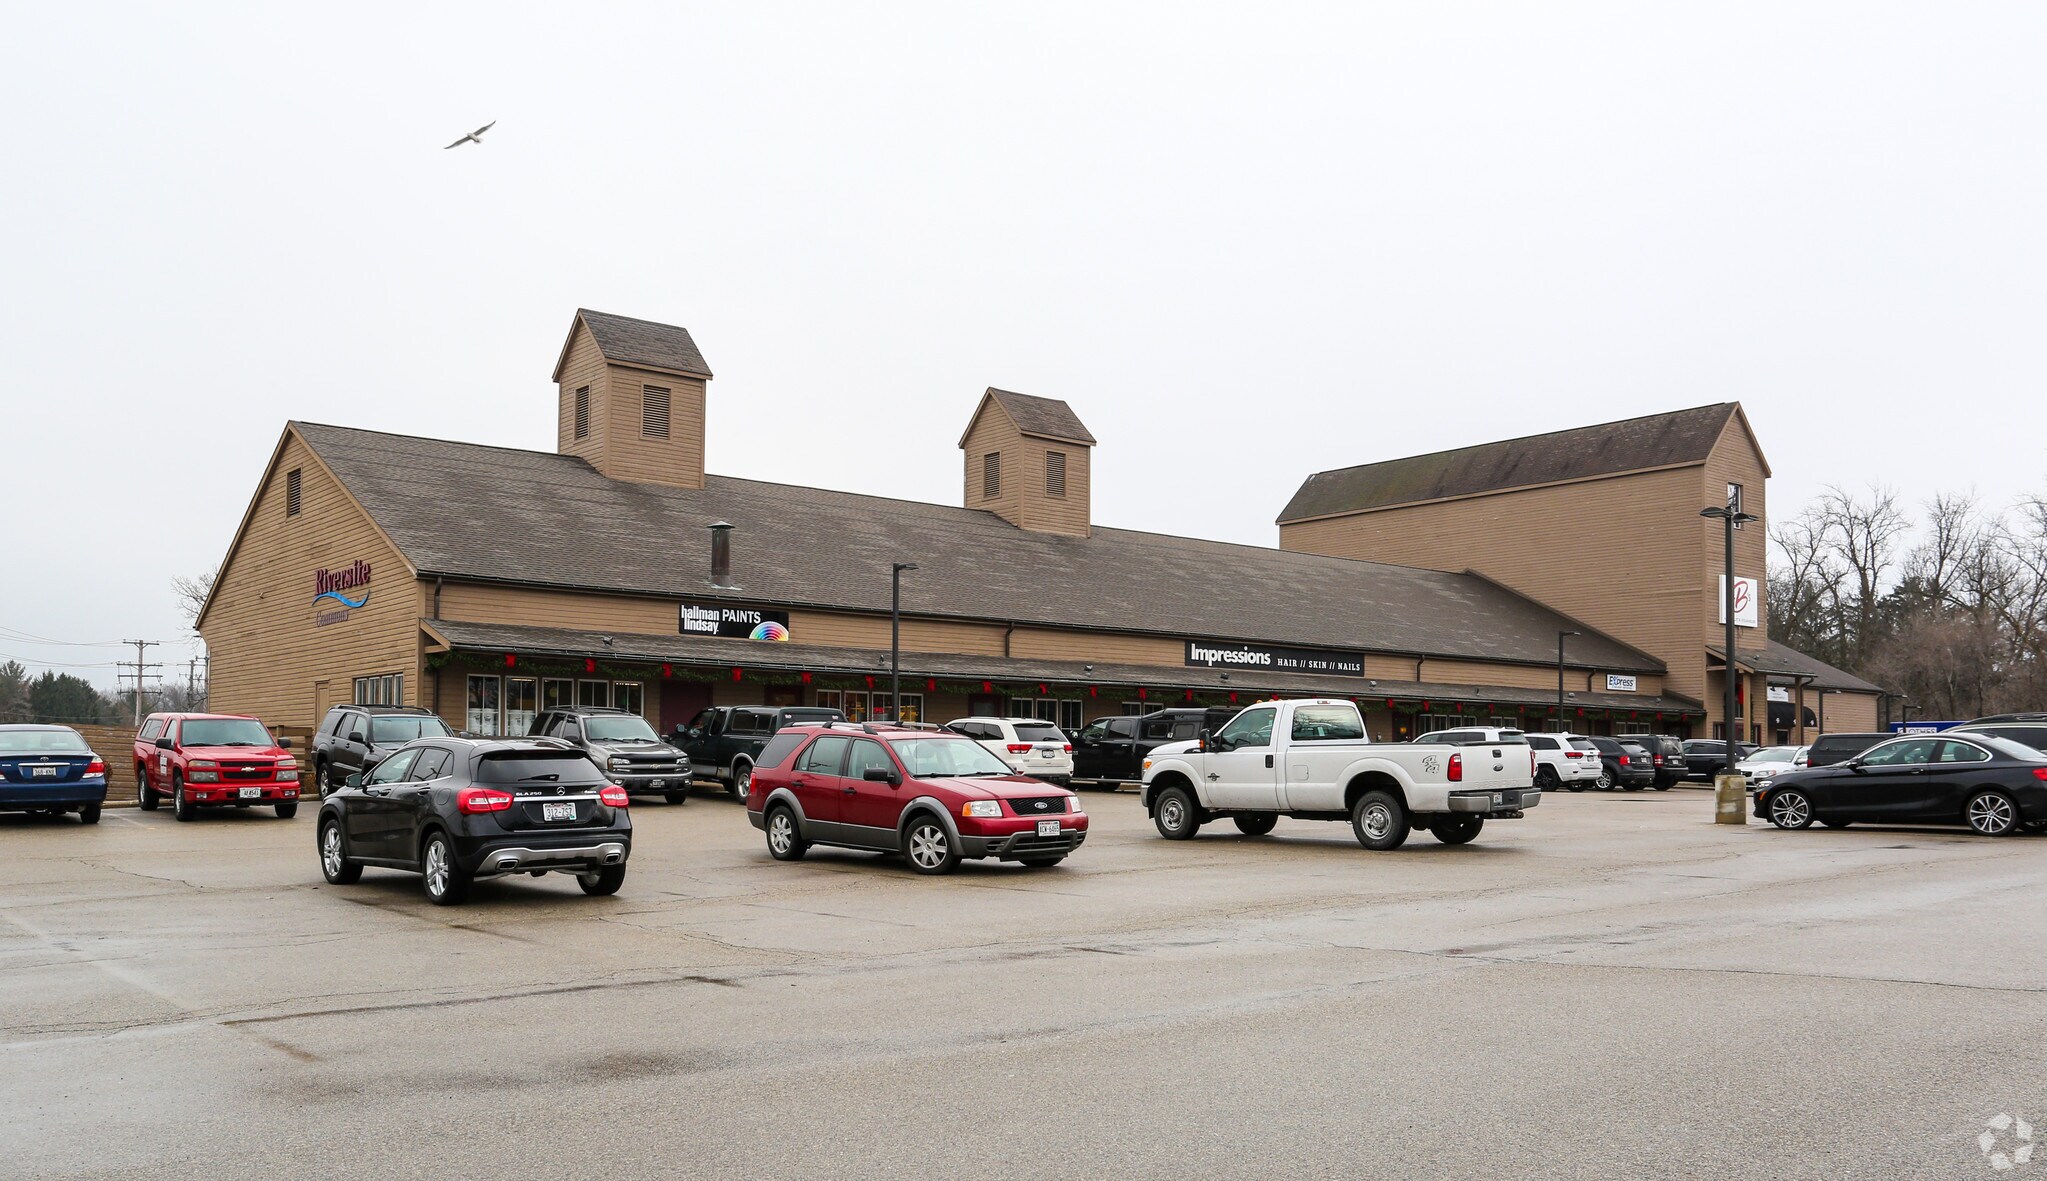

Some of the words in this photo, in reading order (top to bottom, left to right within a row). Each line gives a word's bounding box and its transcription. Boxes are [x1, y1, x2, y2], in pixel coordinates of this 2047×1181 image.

[315, 559, 371, 596] Riversite
[681, 604, 720, 621] hallman
[722, 609, 761, 624] PAINTS
[1191, 643, 1271, 667] Impressions
[1277, 658, 1298, 668] HAIR
[1308, 660, 1327, 669] SKIN
[1337, 662, 1361, 672] NAILS
